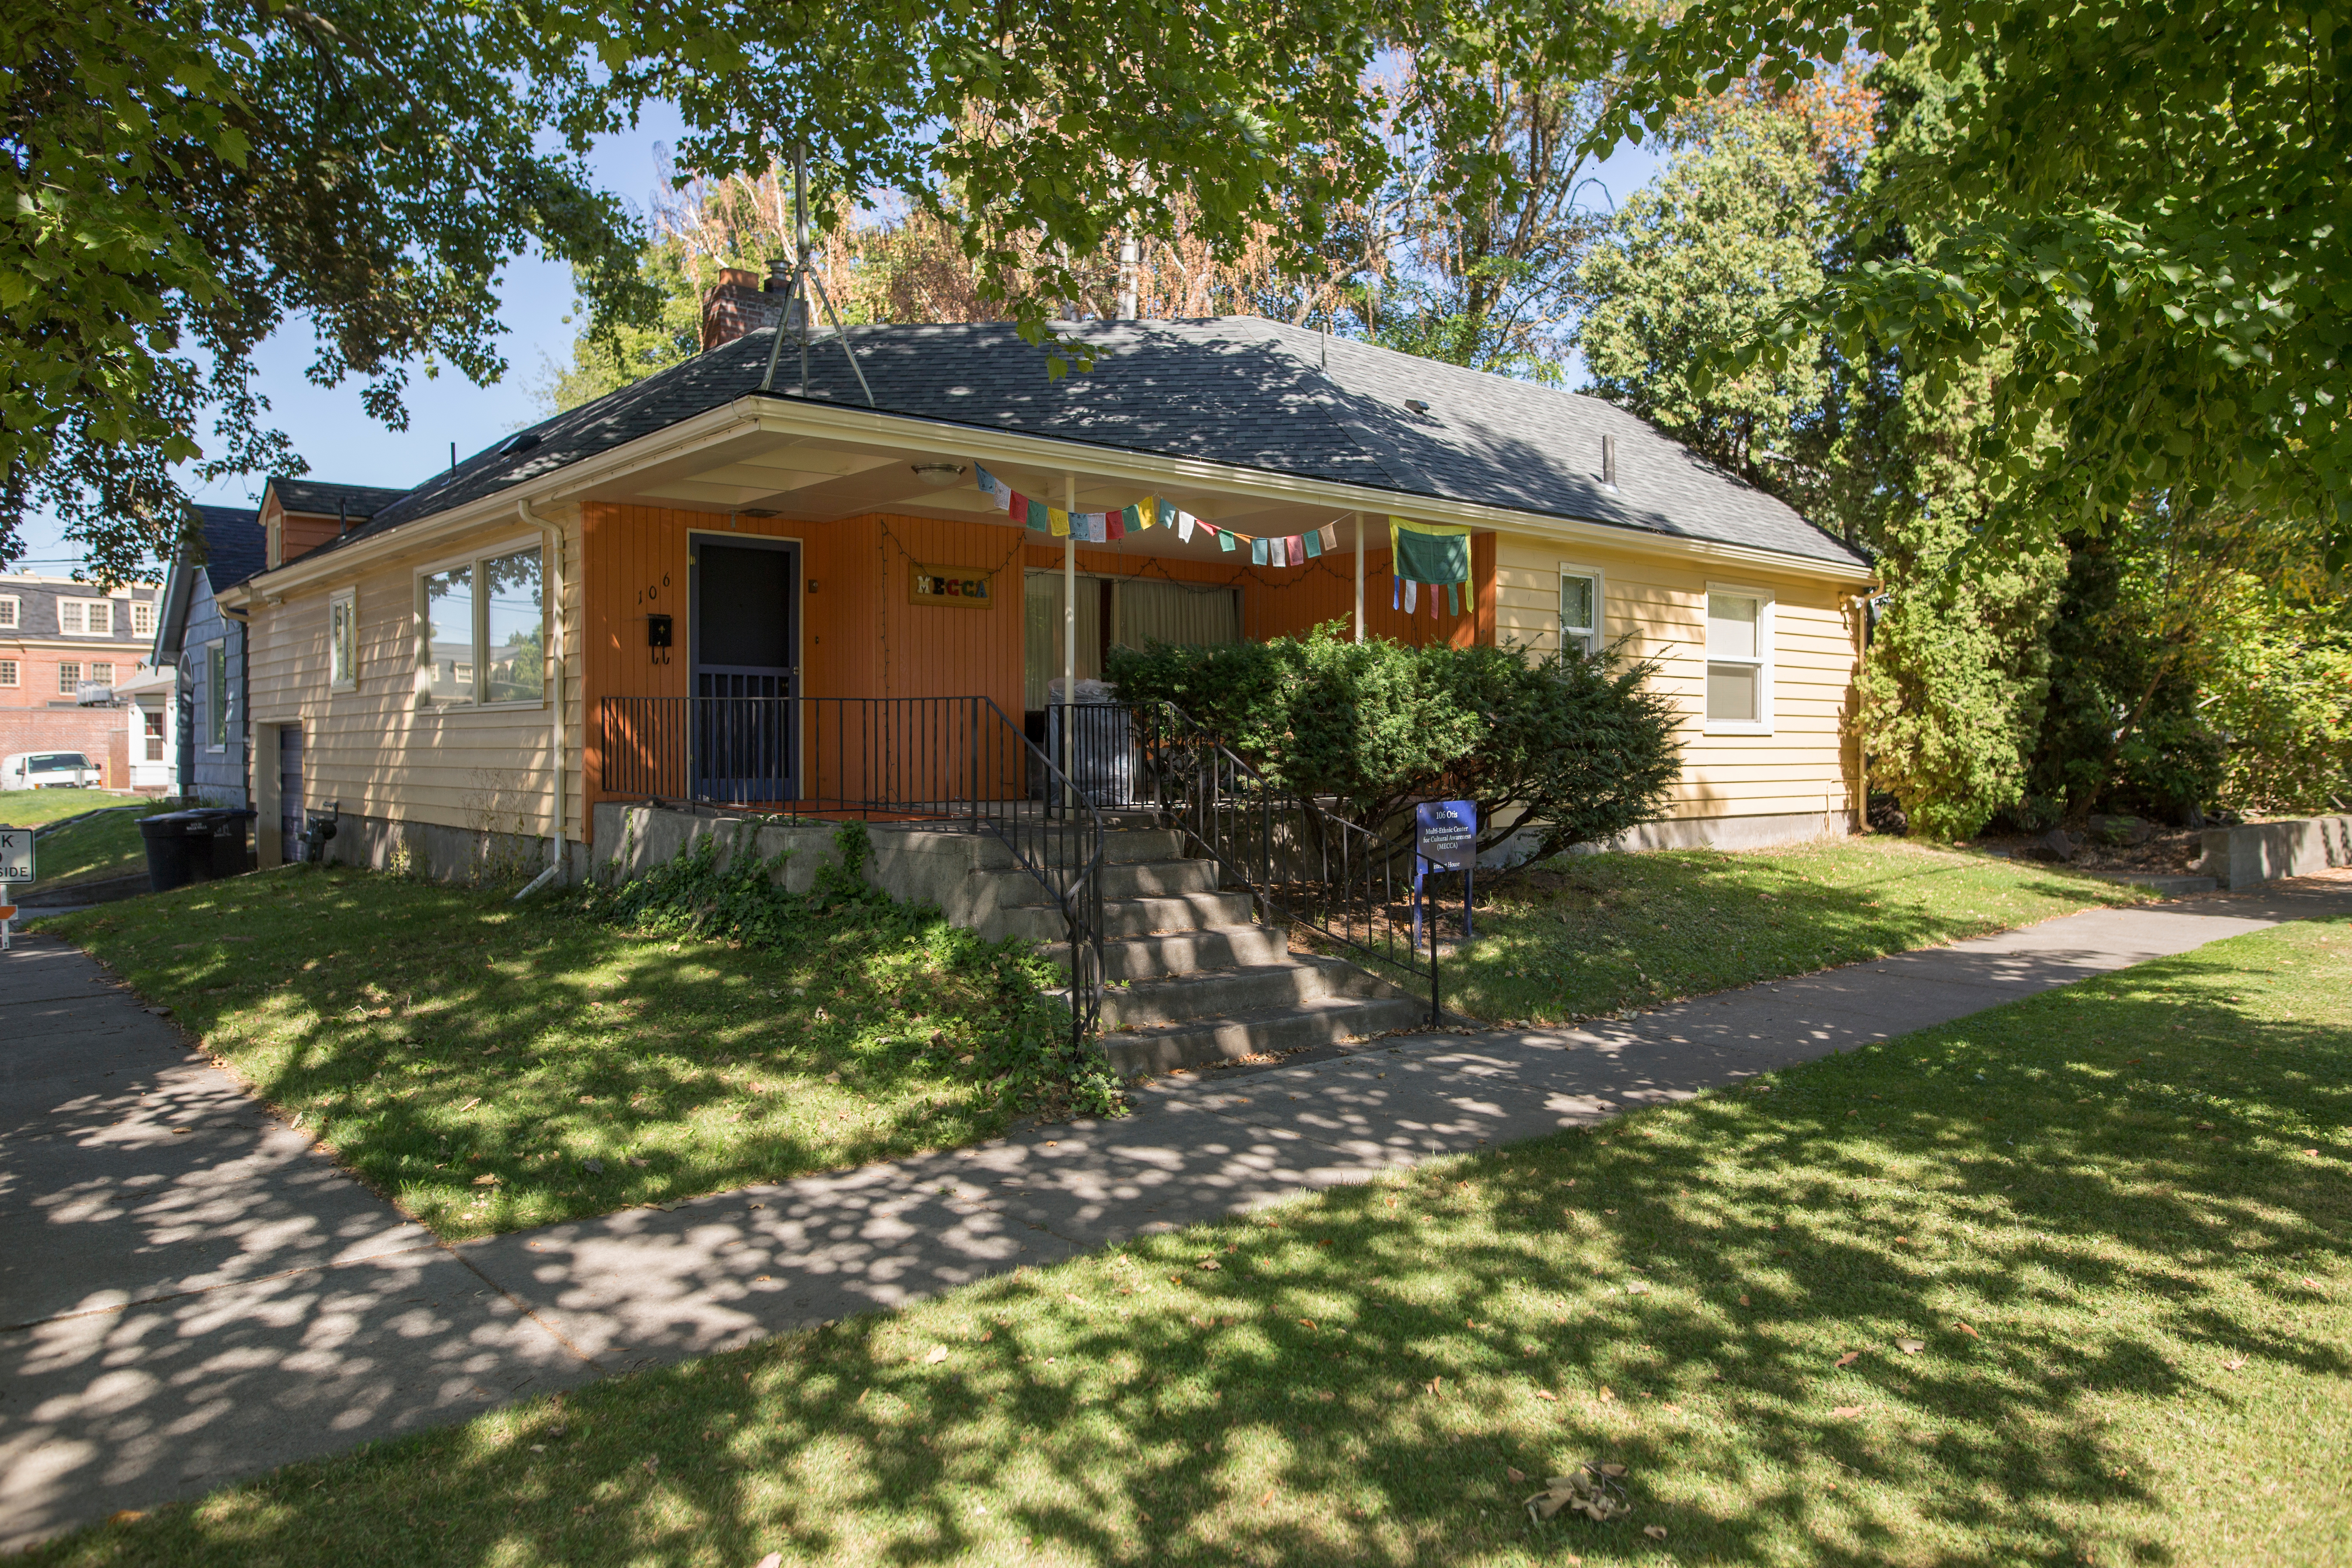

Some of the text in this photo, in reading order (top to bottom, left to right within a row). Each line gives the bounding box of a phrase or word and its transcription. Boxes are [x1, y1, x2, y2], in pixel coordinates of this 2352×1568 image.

[639, 571, 670, 605] 106
[917, 575, 988, 598] MECCA
[1436, 810, 1458, 819] 106 Otis
[1425, 827, 1453, 835] Multi-Ethnic
[1437, 842, 1458, 851] (MECCA)
